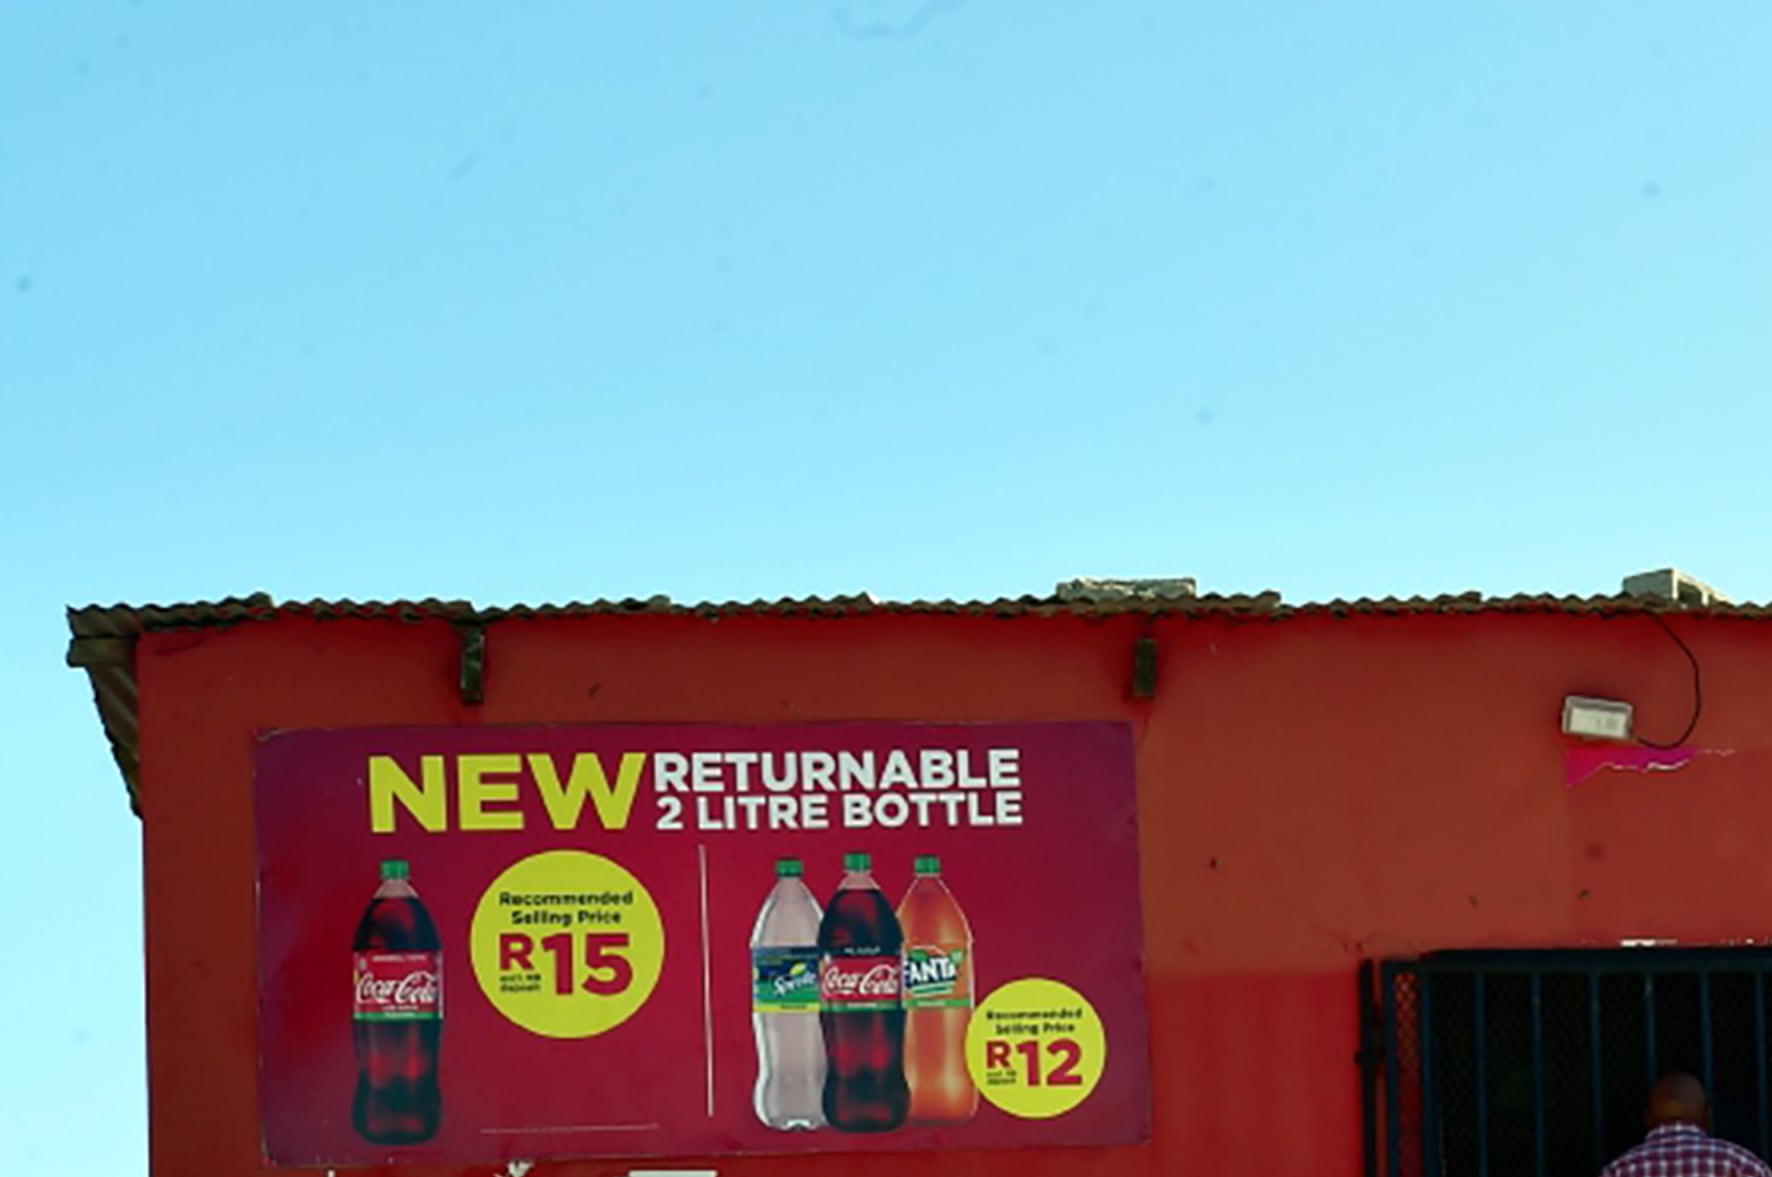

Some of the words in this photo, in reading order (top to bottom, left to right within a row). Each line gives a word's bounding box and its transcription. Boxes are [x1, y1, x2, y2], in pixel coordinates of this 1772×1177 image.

[654, 749, 1021, 792] RETURNABLE
[369, 753, 646, 832] NEW
[656, 796, 683, 829] 2
[697, 794, 829, 829] LITRE
[843, 791, 1023, 827] BOTTLE
[499, 891, 633, 906] Recommended
[512, 910, 572, 926] Selling
[578, 910, 621, 924] Price
[499, 932, 633, 996] R15
[986, 1038, 1082, 1087] R12
